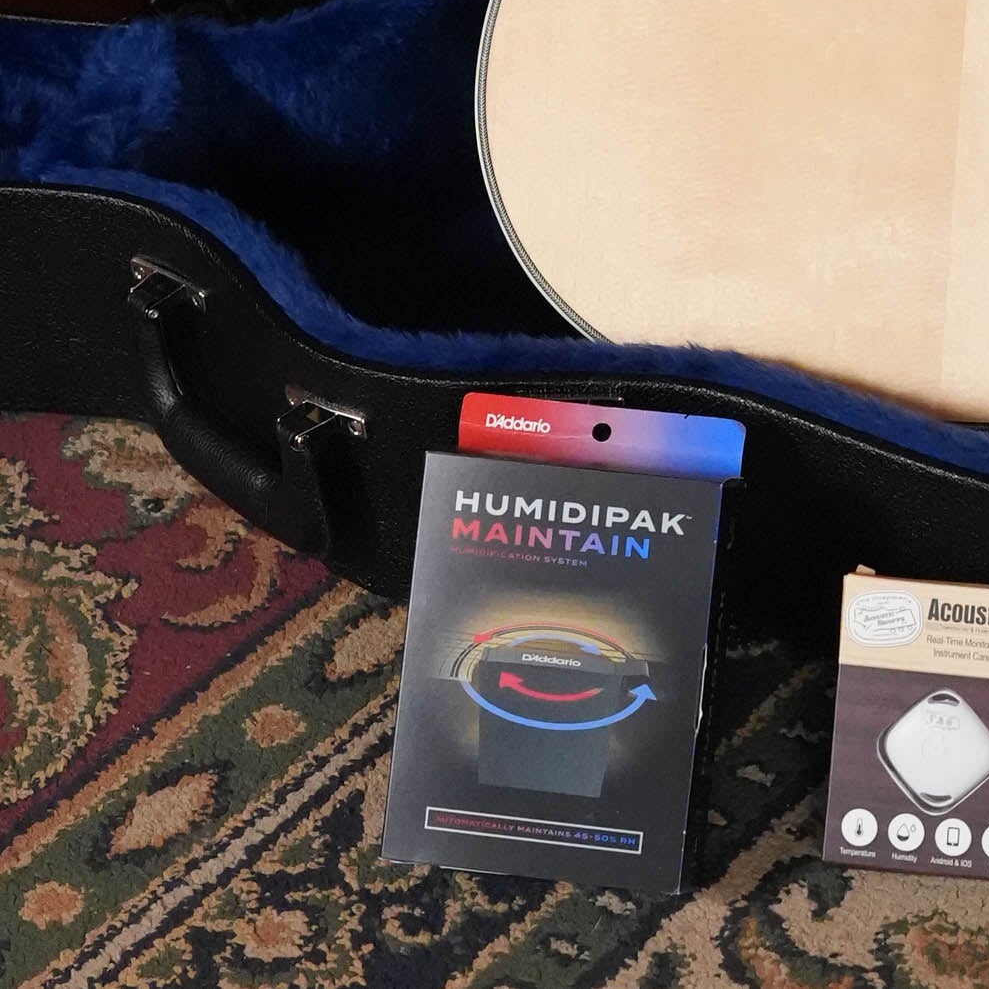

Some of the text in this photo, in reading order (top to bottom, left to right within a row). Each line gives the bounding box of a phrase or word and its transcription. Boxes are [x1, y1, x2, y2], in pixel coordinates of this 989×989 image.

[485, 413, 551, 434] D'Addario
[455, 490, 686, 536] HUMIDIPAK
[452, 517, 650, 560] MAINTAIN
[544, 556, 588, 567] SYSTEM
[926, 635, 964, 648] Real-Time
[521, 652, 581, 668] D'Addario
[933, 649, 971, 661] Instrument
[972, 651, 989, 662] Care
[435, 815, 515, 831] AUTOMATICALLY
[516, 825, 571, 838] MAINTAINS
[840, 847, 876, 858] Temperature
[891, 852, 917, 863] Humidity
[930, 857, 954, 867] Android
[954, 859, 960, 867] &
